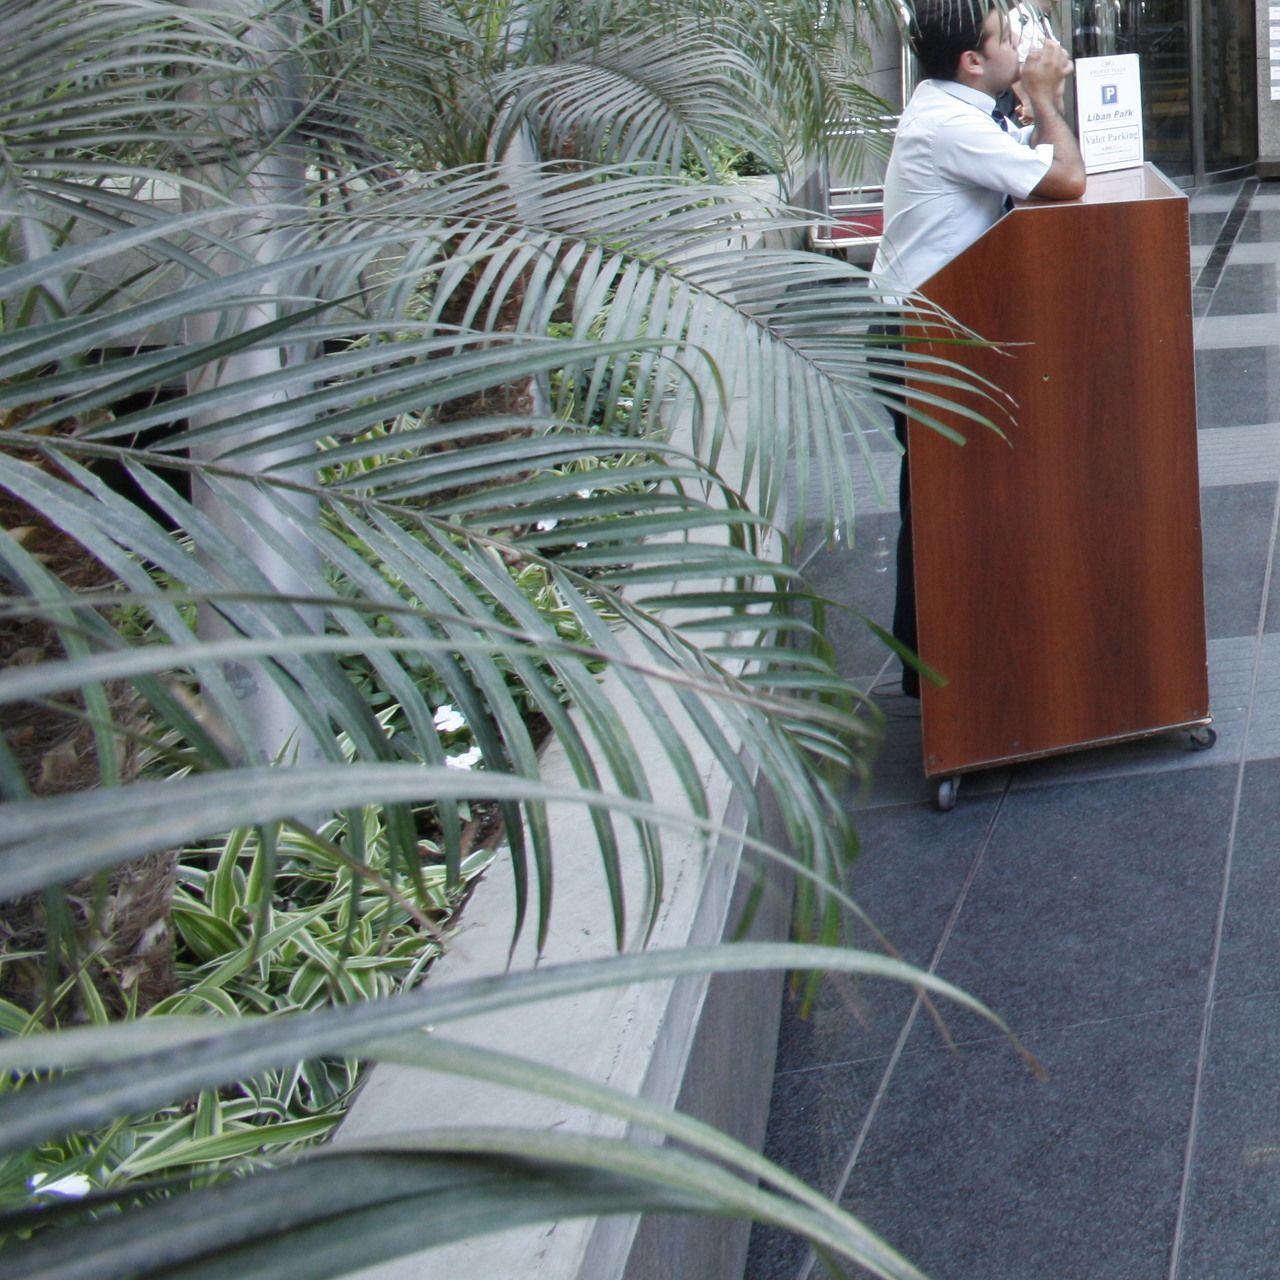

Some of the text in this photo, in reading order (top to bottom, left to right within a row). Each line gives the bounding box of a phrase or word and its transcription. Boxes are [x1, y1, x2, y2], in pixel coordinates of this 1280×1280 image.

[1087, 108, 1133, 122] Liban Park
[1085, 130, 1140, 145] Valet Parking
